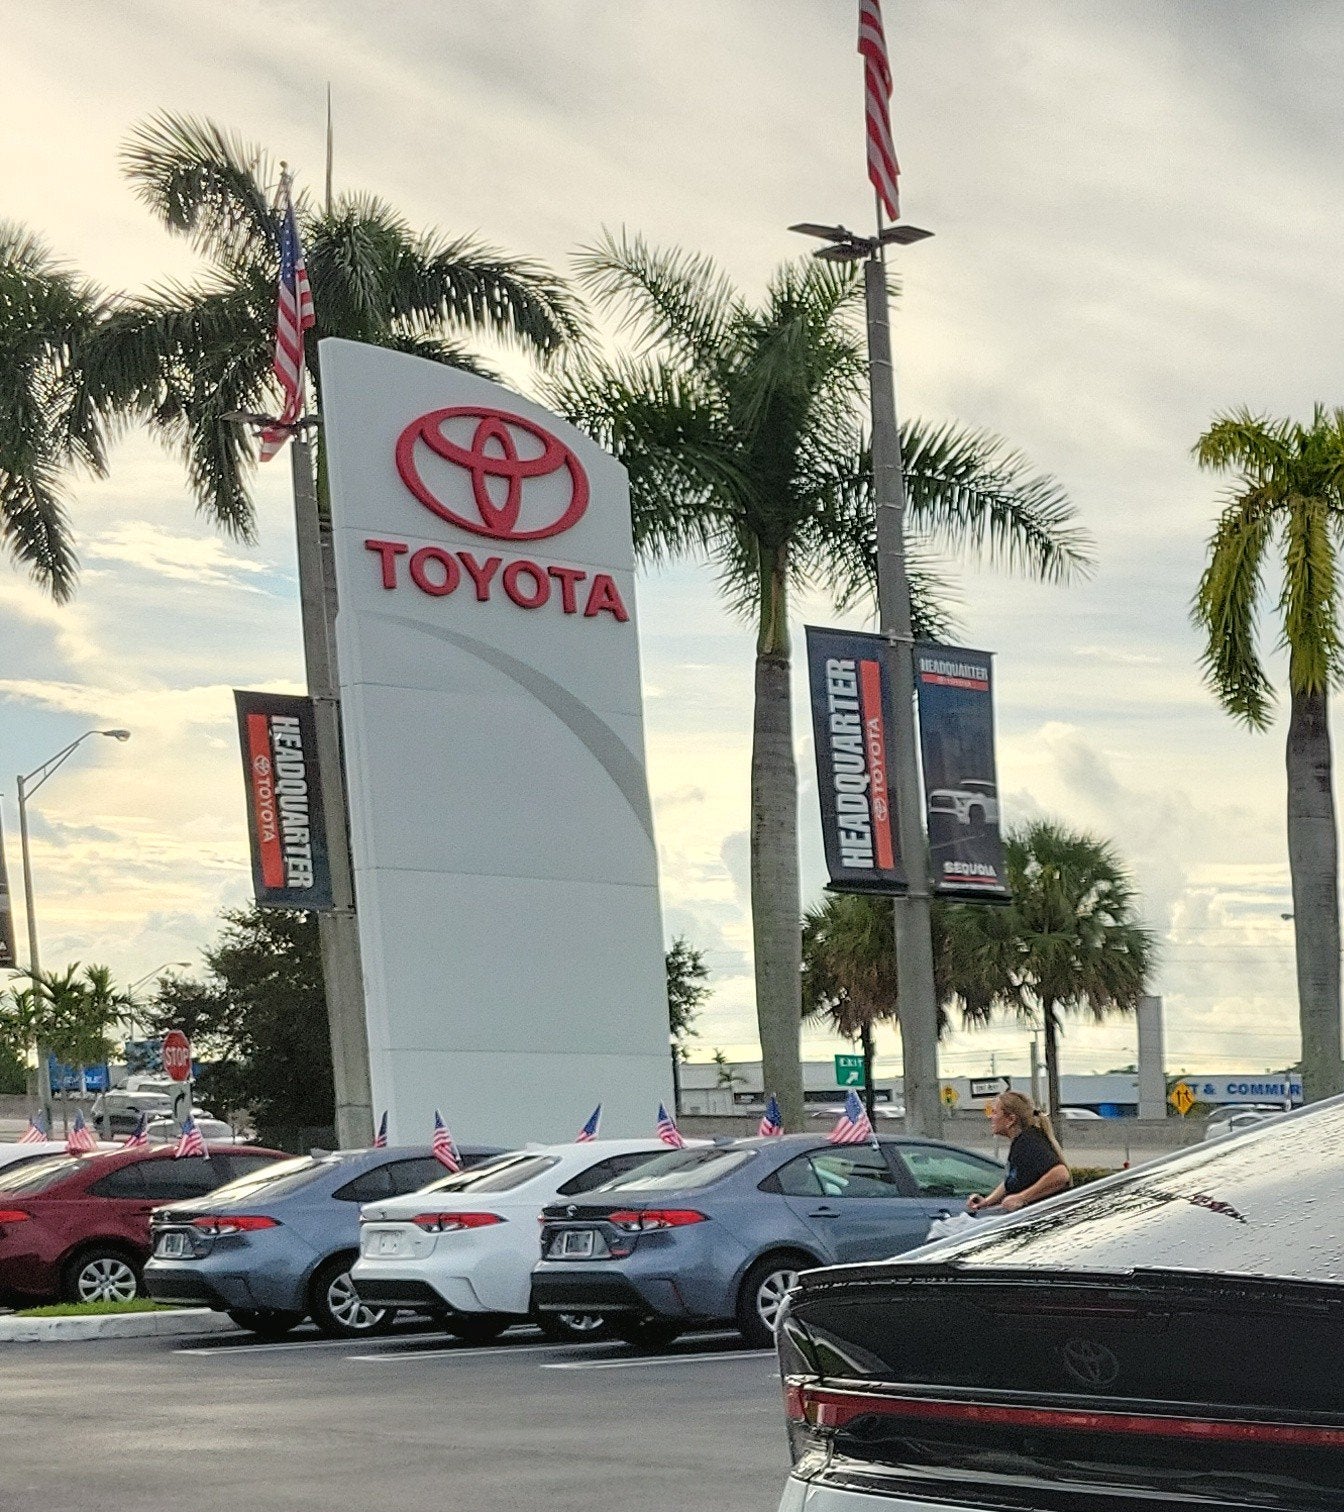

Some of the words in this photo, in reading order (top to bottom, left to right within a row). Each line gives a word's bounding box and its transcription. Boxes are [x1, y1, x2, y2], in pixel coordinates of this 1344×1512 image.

[364, 539, 629, 623] TOYOTA
[825, 658, 875, 869] HEADQUARTER
[867, 717, 888, 798] TOYOTA
[257, 777, 277, 843] TOYOTA
[271, 715, 315, 889] HEADQUARTER
[166, 1046, 190, 1066] STOP
[840, 1057, 864, 1067] EXIT
